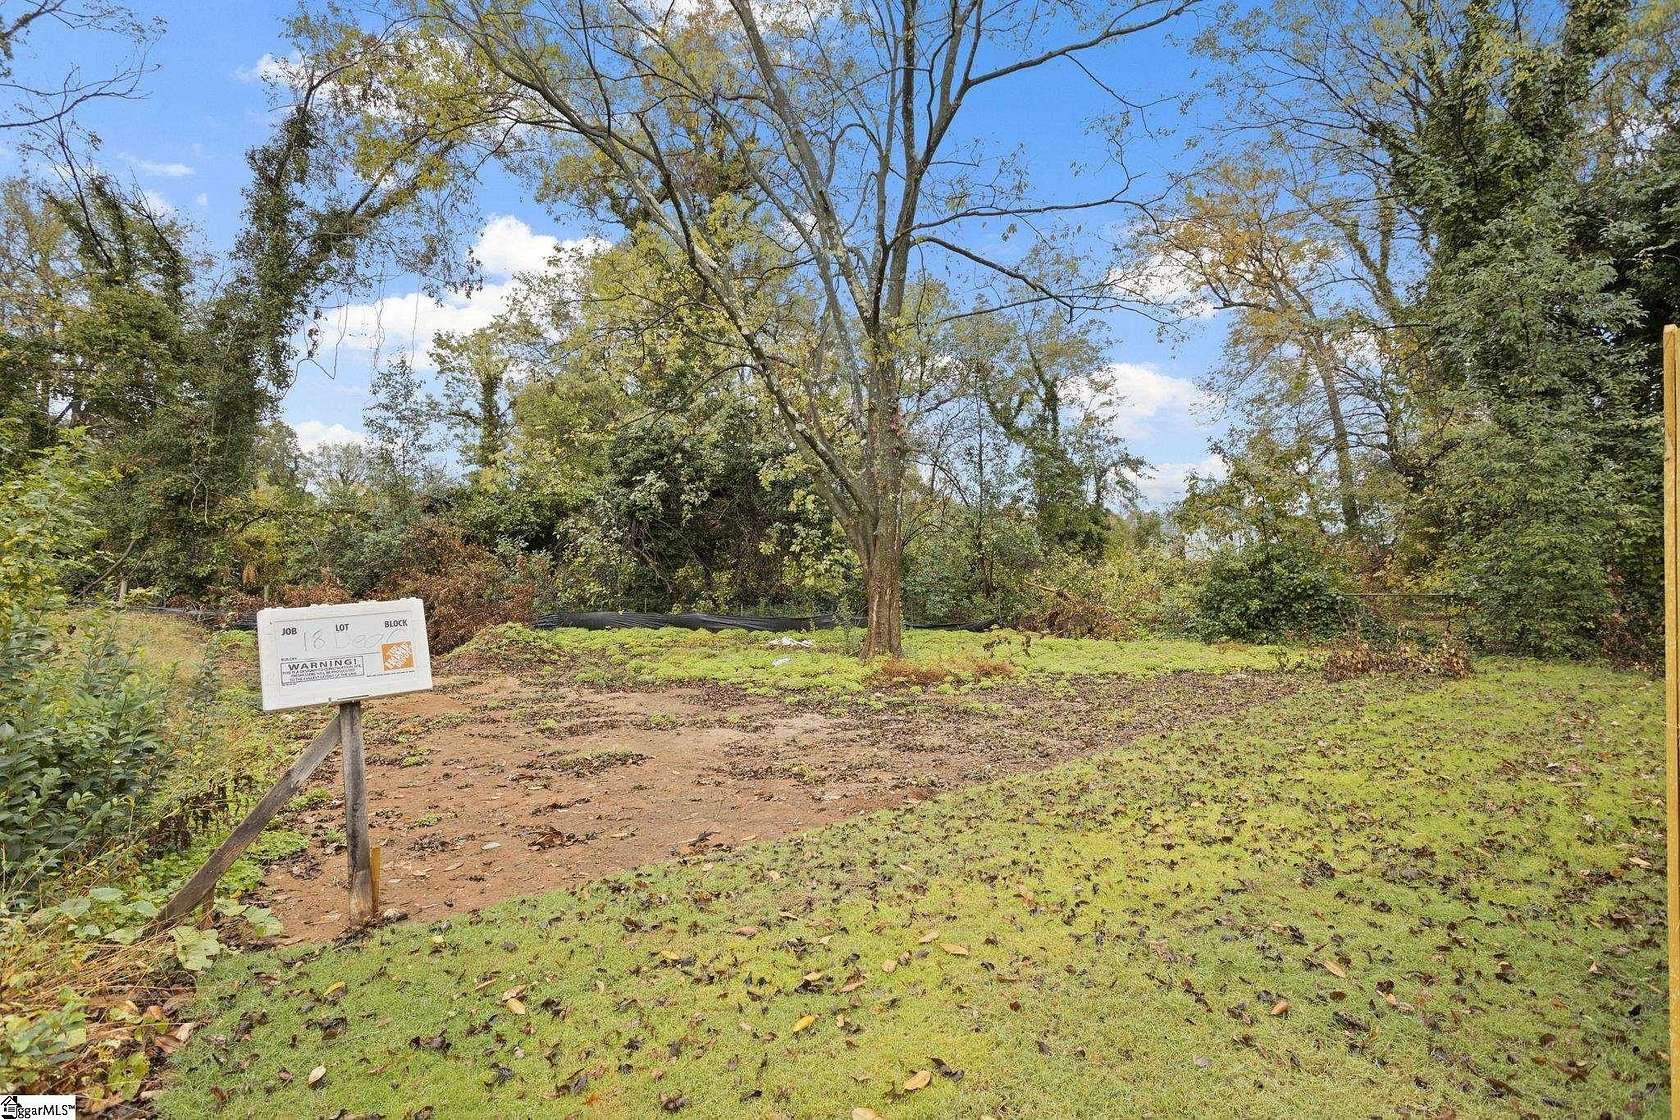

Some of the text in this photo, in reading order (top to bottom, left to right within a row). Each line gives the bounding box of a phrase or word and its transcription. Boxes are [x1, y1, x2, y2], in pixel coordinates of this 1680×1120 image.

[281, 618, 408, 636] JOB LOT BLOCK
[288, 659, 357, 671] WARNING!
